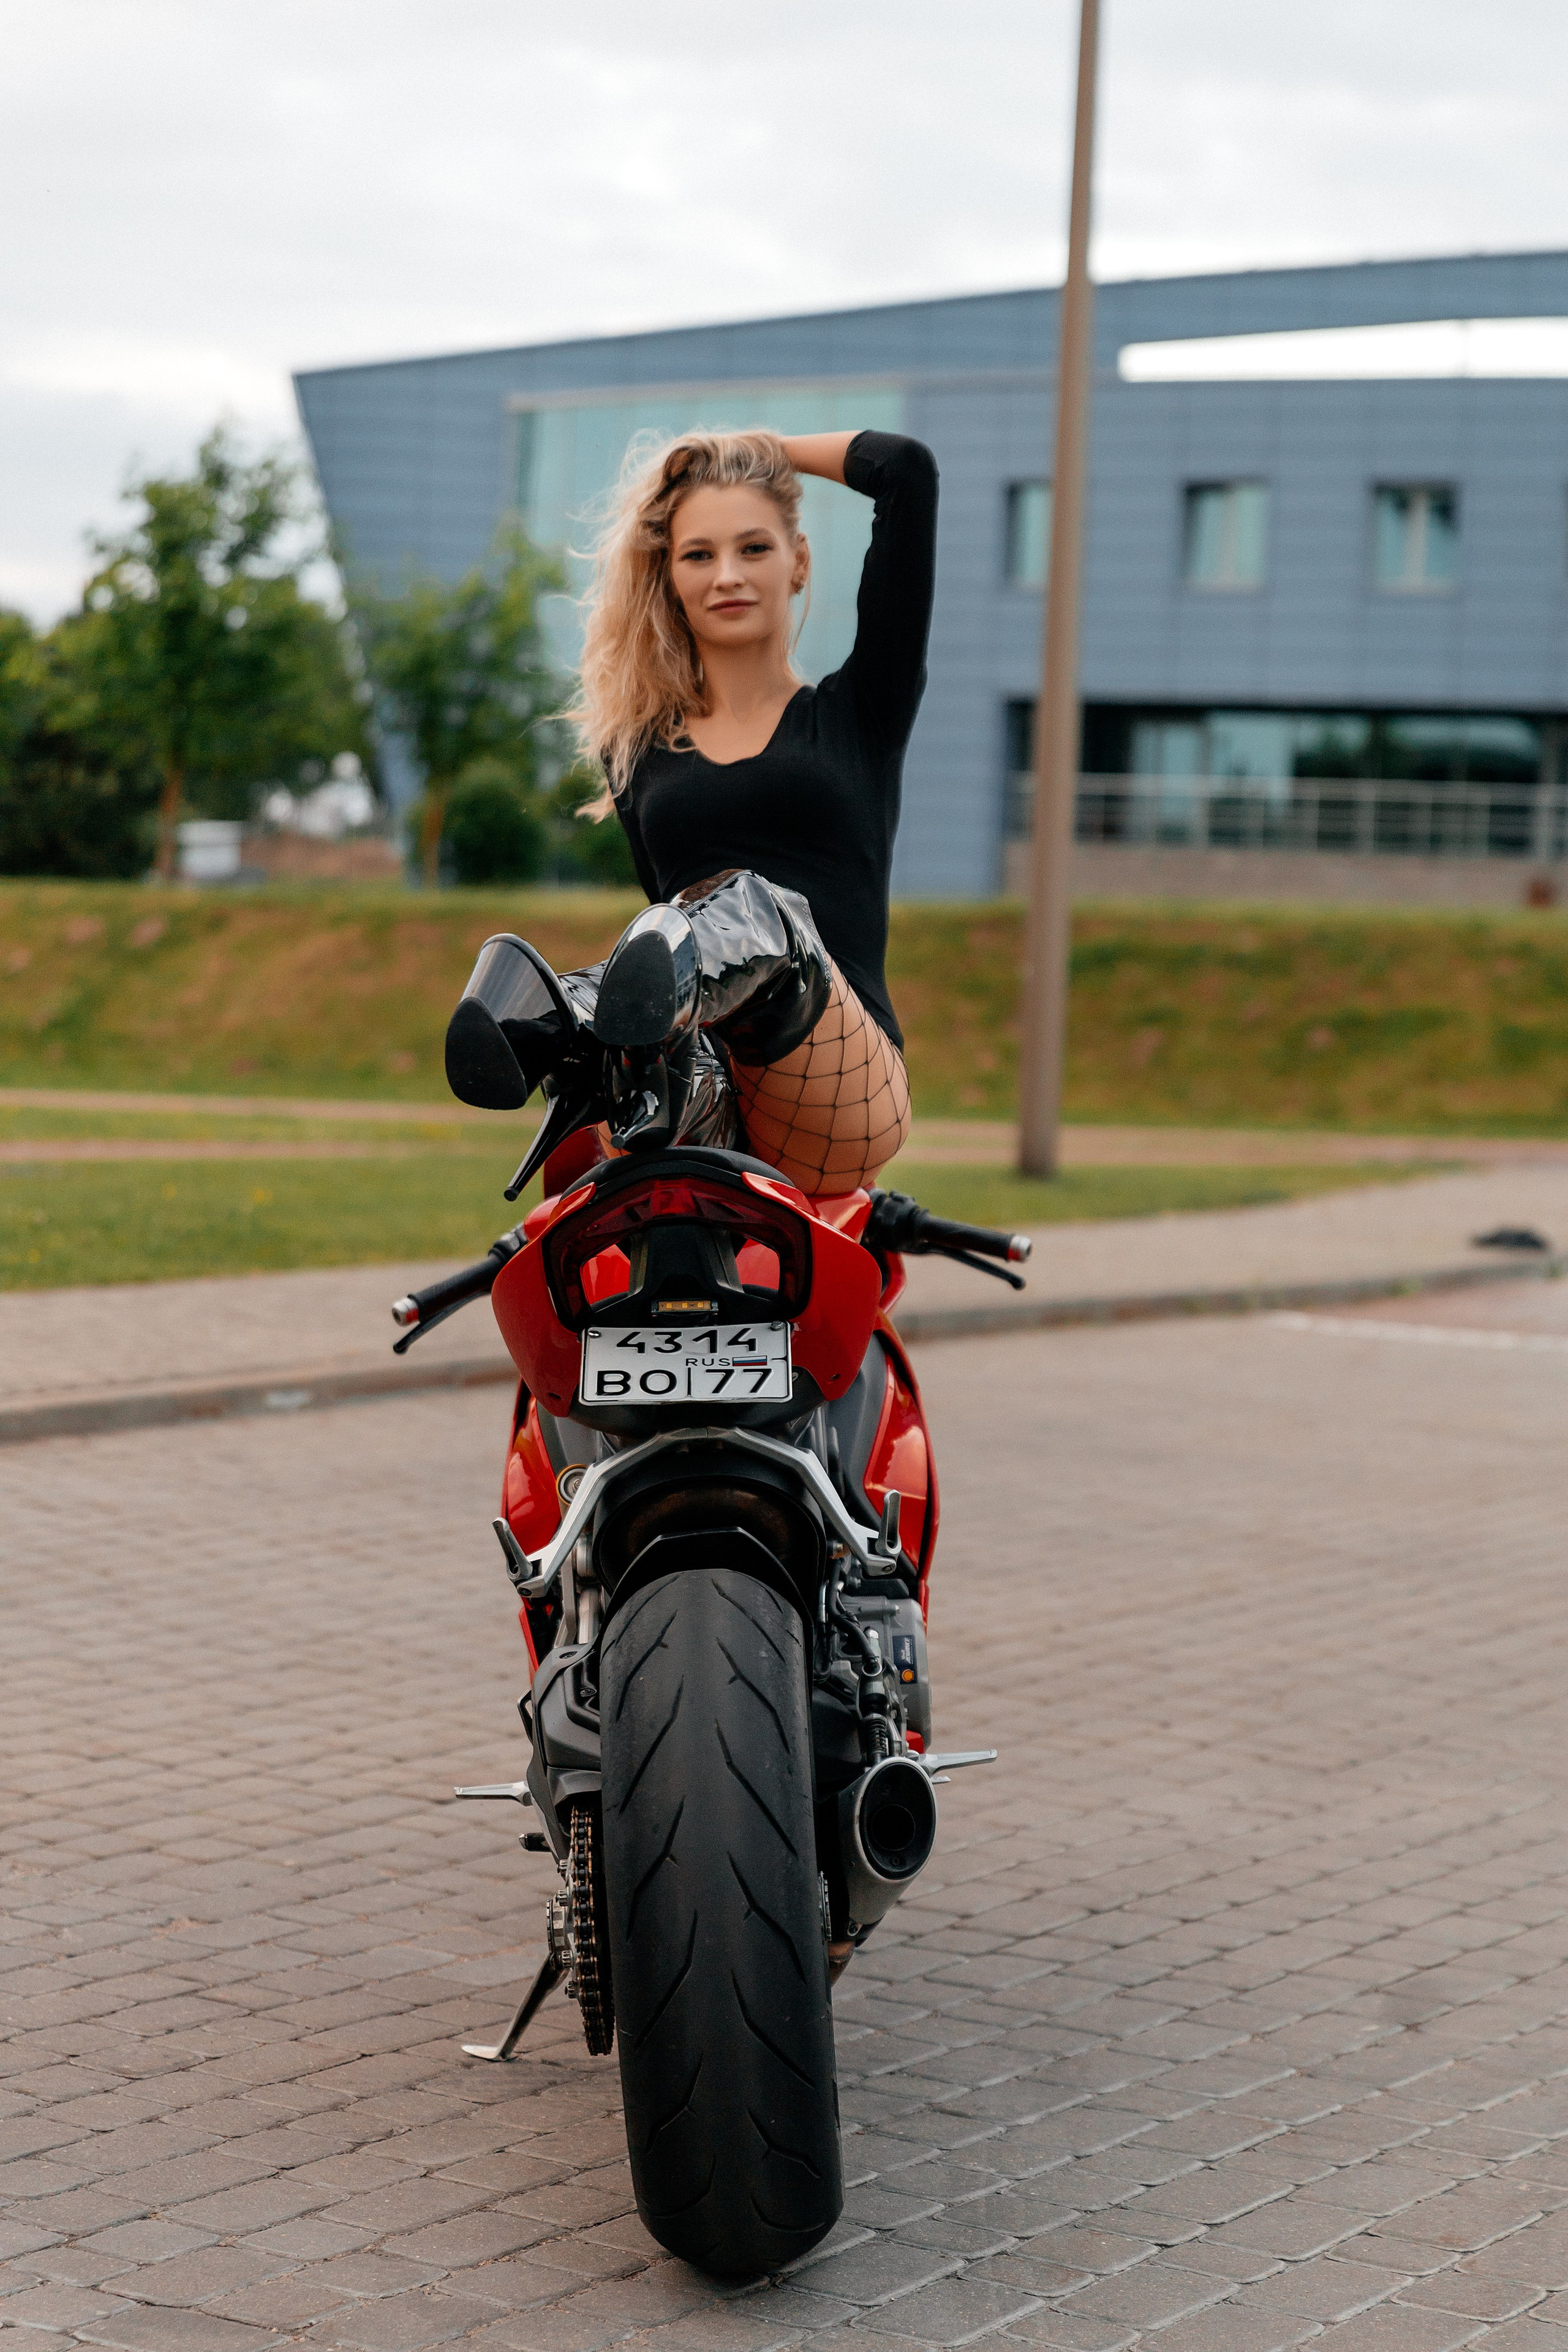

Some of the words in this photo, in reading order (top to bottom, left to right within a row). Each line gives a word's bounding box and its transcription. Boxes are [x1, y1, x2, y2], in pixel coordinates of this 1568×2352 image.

[616, 1327, 756, 1354] 4314
[685, 1358, 731, 1366] RUS
[596, 1369, 678, 1396] BO
[705, 1368, 772, 1395] 77
